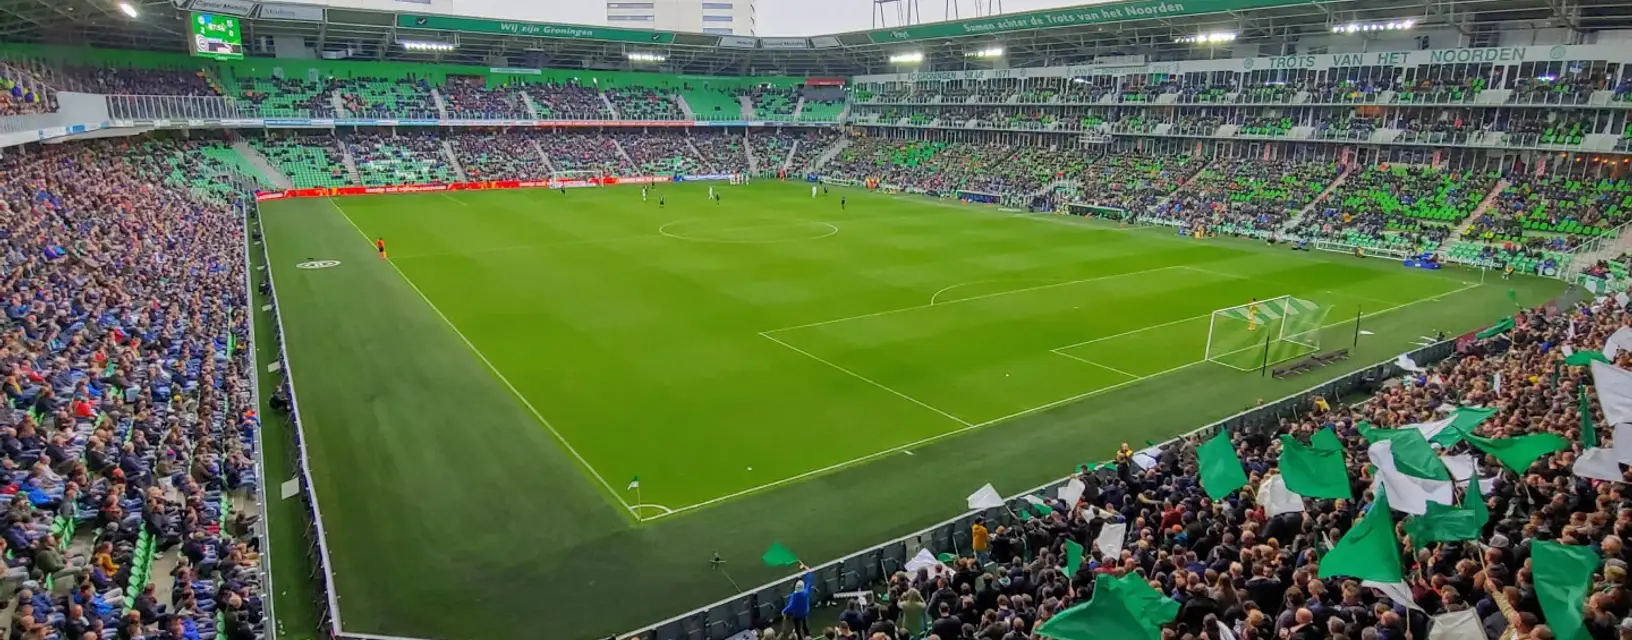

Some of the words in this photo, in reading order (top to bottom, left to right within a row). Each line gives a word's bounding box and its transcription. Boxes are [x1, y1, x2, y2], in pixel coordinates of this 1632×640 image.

[963, 23, 995, 32] Samen
[997, 18, 1028, 29] achter
[1031, 15, 1043, 26] de
[1045, 14, 1075, 24] Trots
[1078, 12, 1099, 20] van
[1101, 8, 1122, 18] het
[1125, 2, 1184, 16] Noorden
[500, 22, 518, 32] Wij
[521, 25, 540, 34] zijn
[543, 26, 593, 36] Groningen
[1269, 56, 1316, 68] TROTS
[1333, 54, 1364, 66] VAN
[1377, 52, 1411, 64] HET
[1430, 48, 1526, 63] NOORDEN
